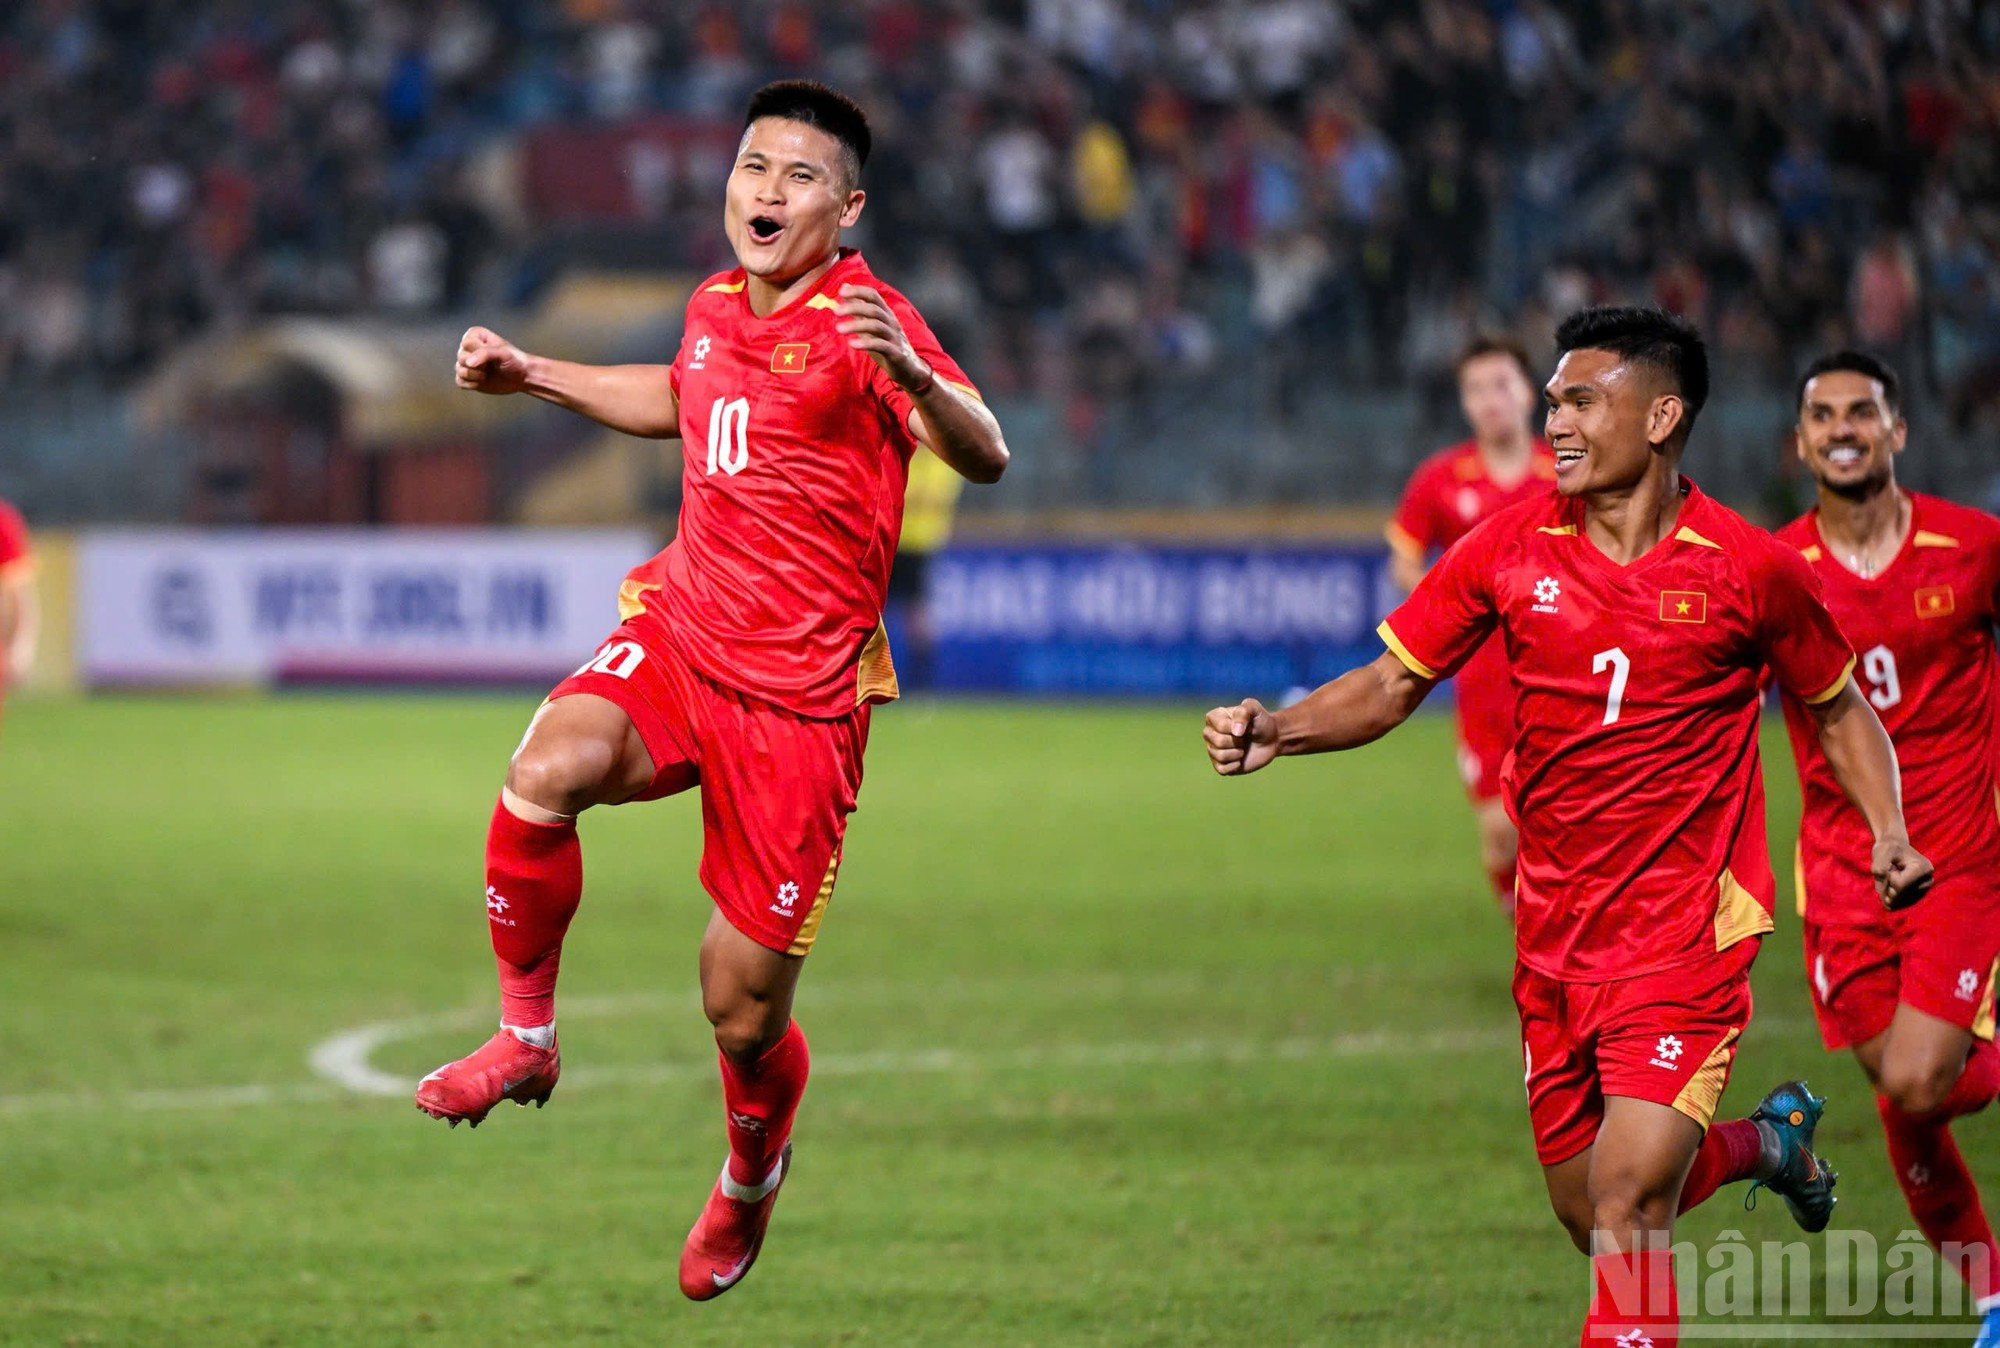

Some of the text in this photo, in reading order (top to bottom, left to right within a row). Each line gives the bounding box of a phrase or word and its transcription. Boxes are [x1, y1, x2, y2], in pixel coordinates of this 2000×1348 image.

[706, 397, 750, 476] 10
[572, 642, 646, 680] 10
[1592, 647, 1631, 726] 7
[1864, 644, 1902, 711] 9
